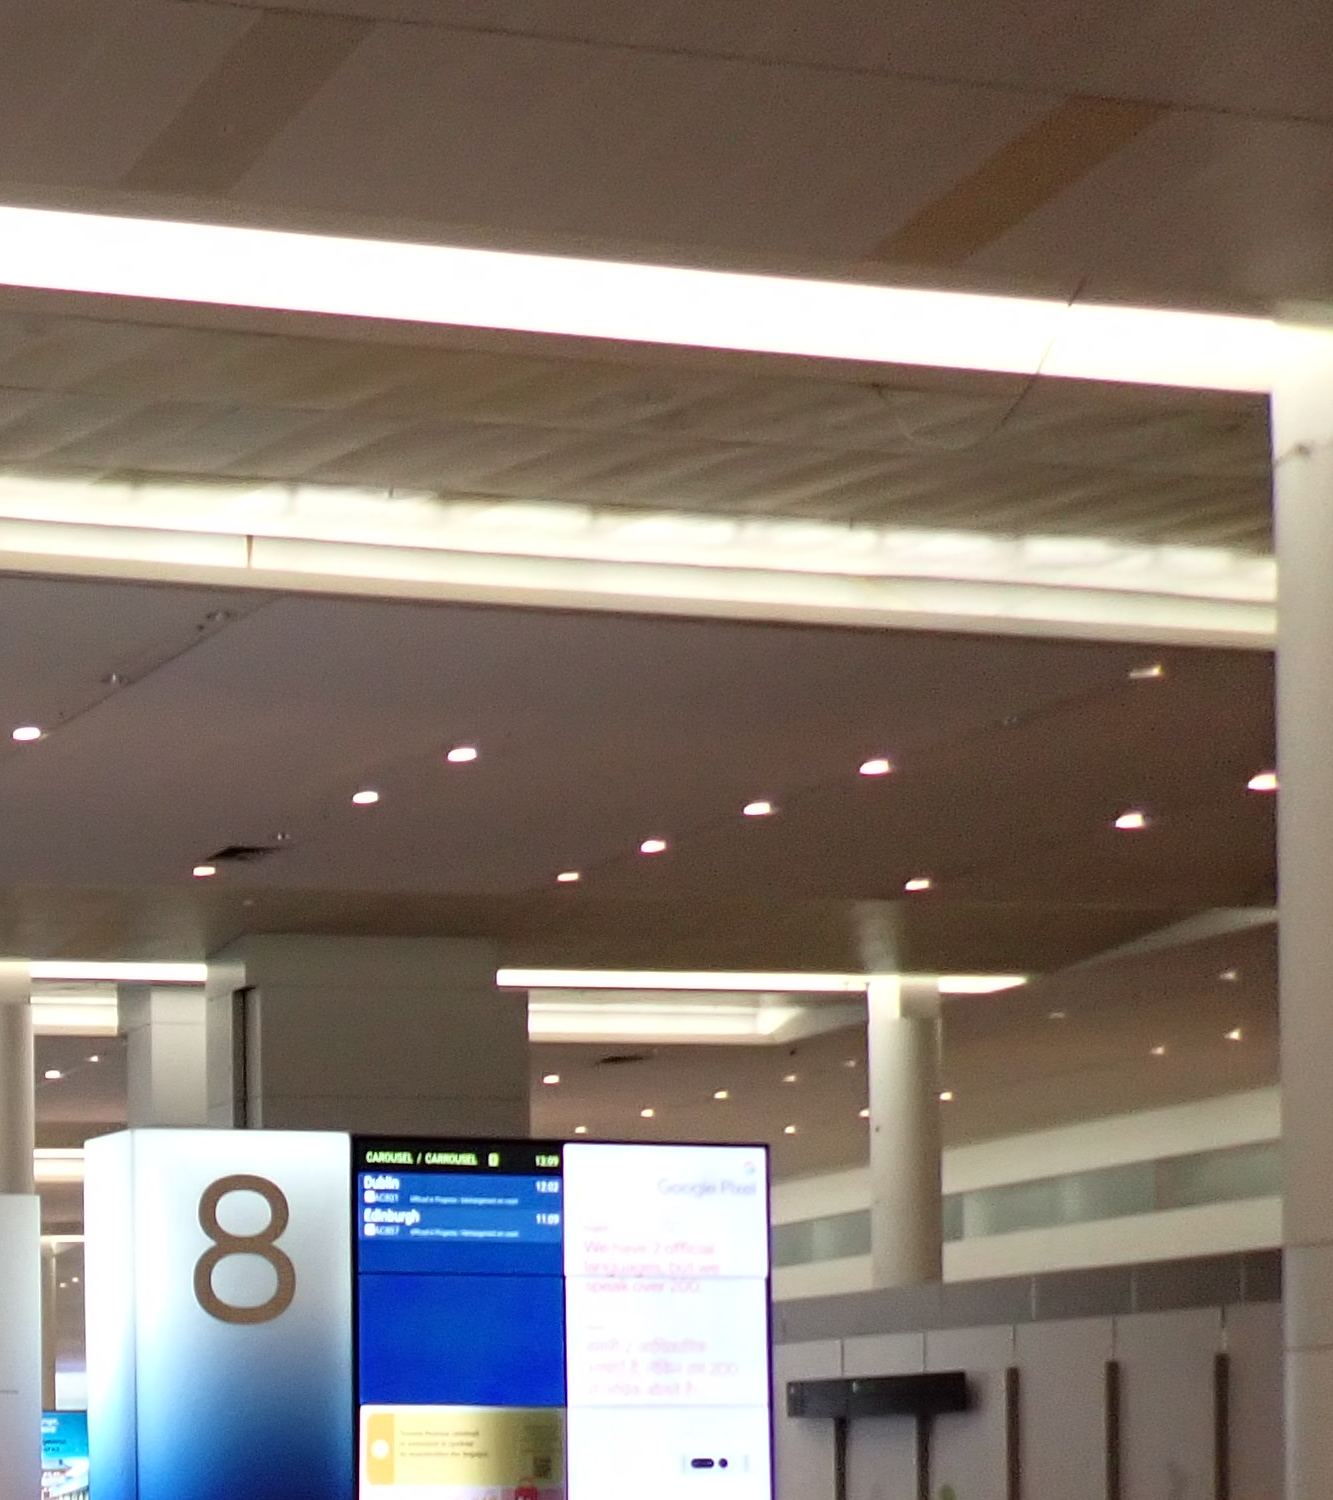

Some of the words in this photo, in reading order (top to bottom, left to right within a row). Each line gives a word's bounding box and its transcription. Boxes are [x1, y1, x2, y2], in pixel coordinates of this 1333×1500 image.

[366, 1151, 413, 1164] CAROUSEL
[425, 1153, 478, 1165] CARROUSEL
[364, 1175, 400, 1189] Dublin
[364, 1208, 420, 1225] Edinburgh
[193, 1173, 296, 1324] 8
